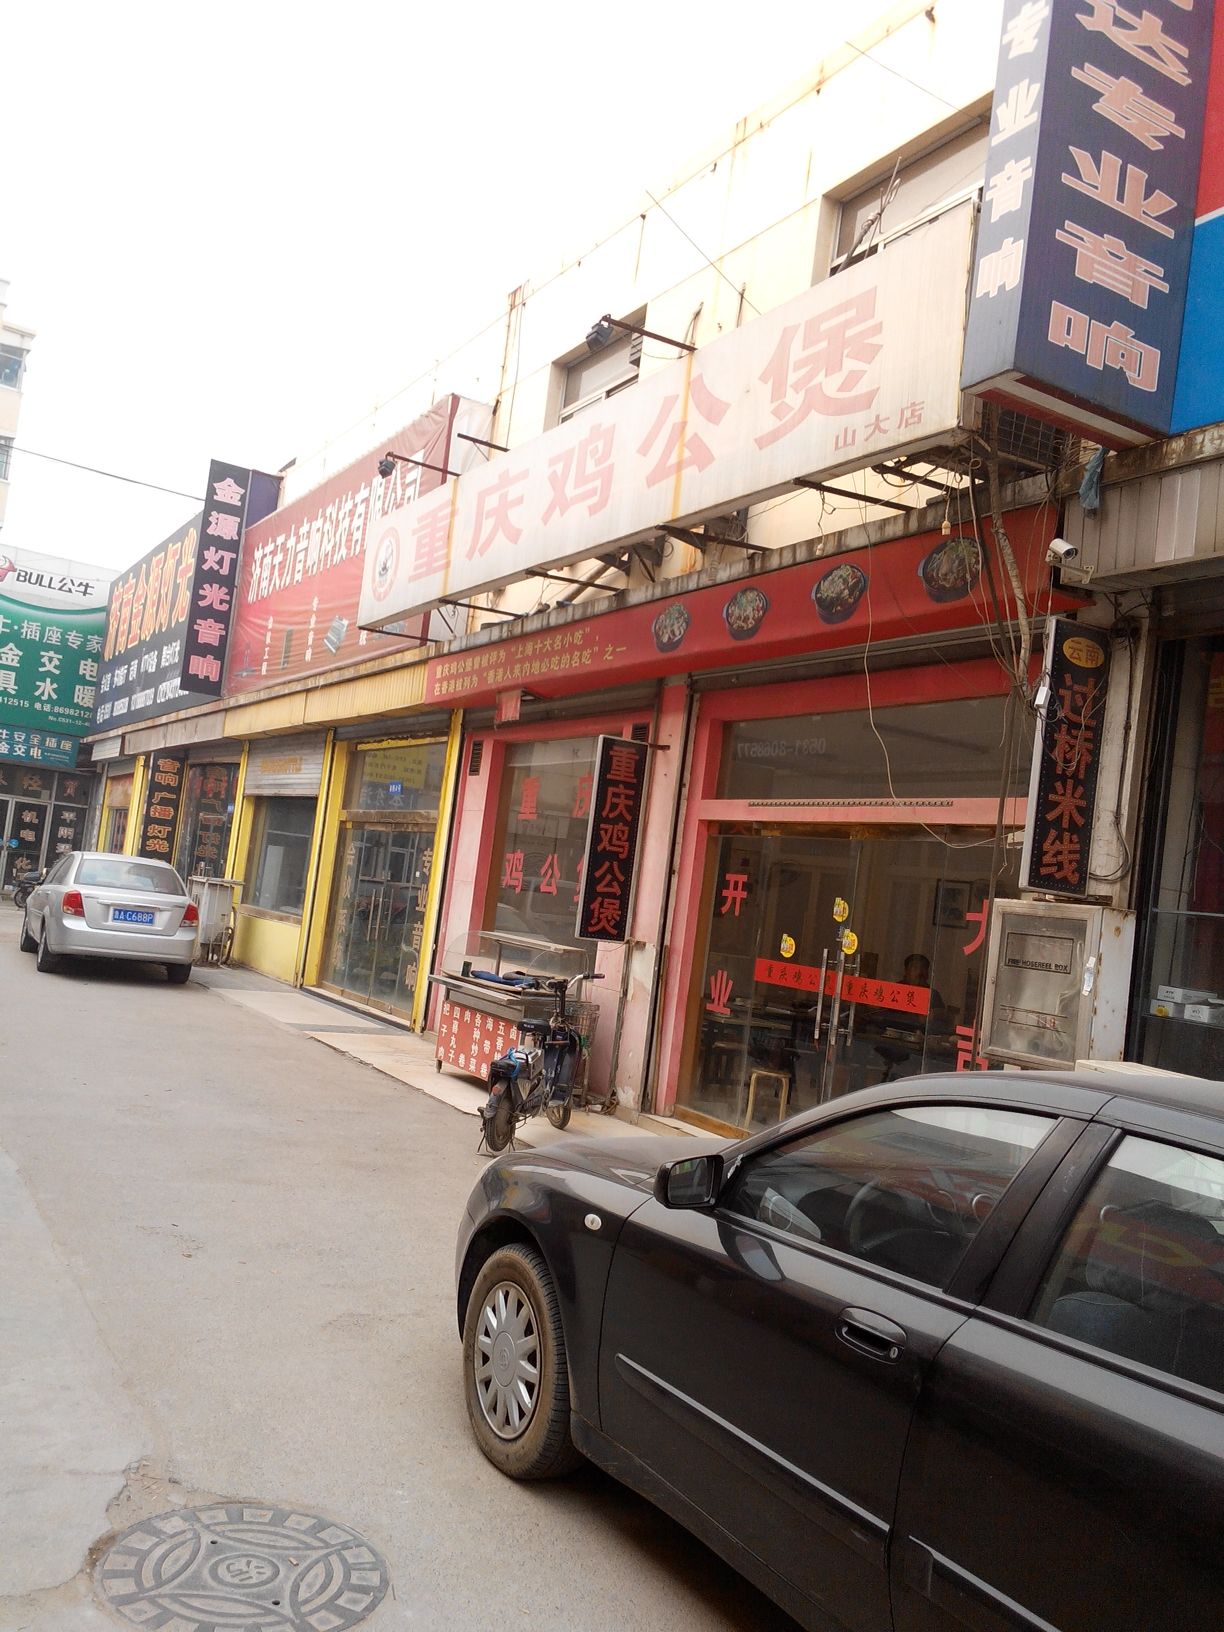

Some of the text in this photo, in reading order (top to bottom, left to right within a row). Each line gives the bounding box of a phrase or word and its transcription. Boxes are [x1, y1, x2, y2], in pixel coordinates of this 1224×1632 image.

[976, 0, 1048, 298] 专业音响
[1048, 0, 1193, 391] 达专业音响
[408, 286, 884, 583] 重庆鸡公煲
[834, 400, 925, 451] 山大店
[188, 477, 245, 682] 金源灯光音响
[1067, 639, 1101, 664] 云南
[145, 758, 180, 853] 音响广播灯光
[587, 745, 640, 936] 重庆鸡公煲
[1040, 673, 1099, 883] 过桥米线
